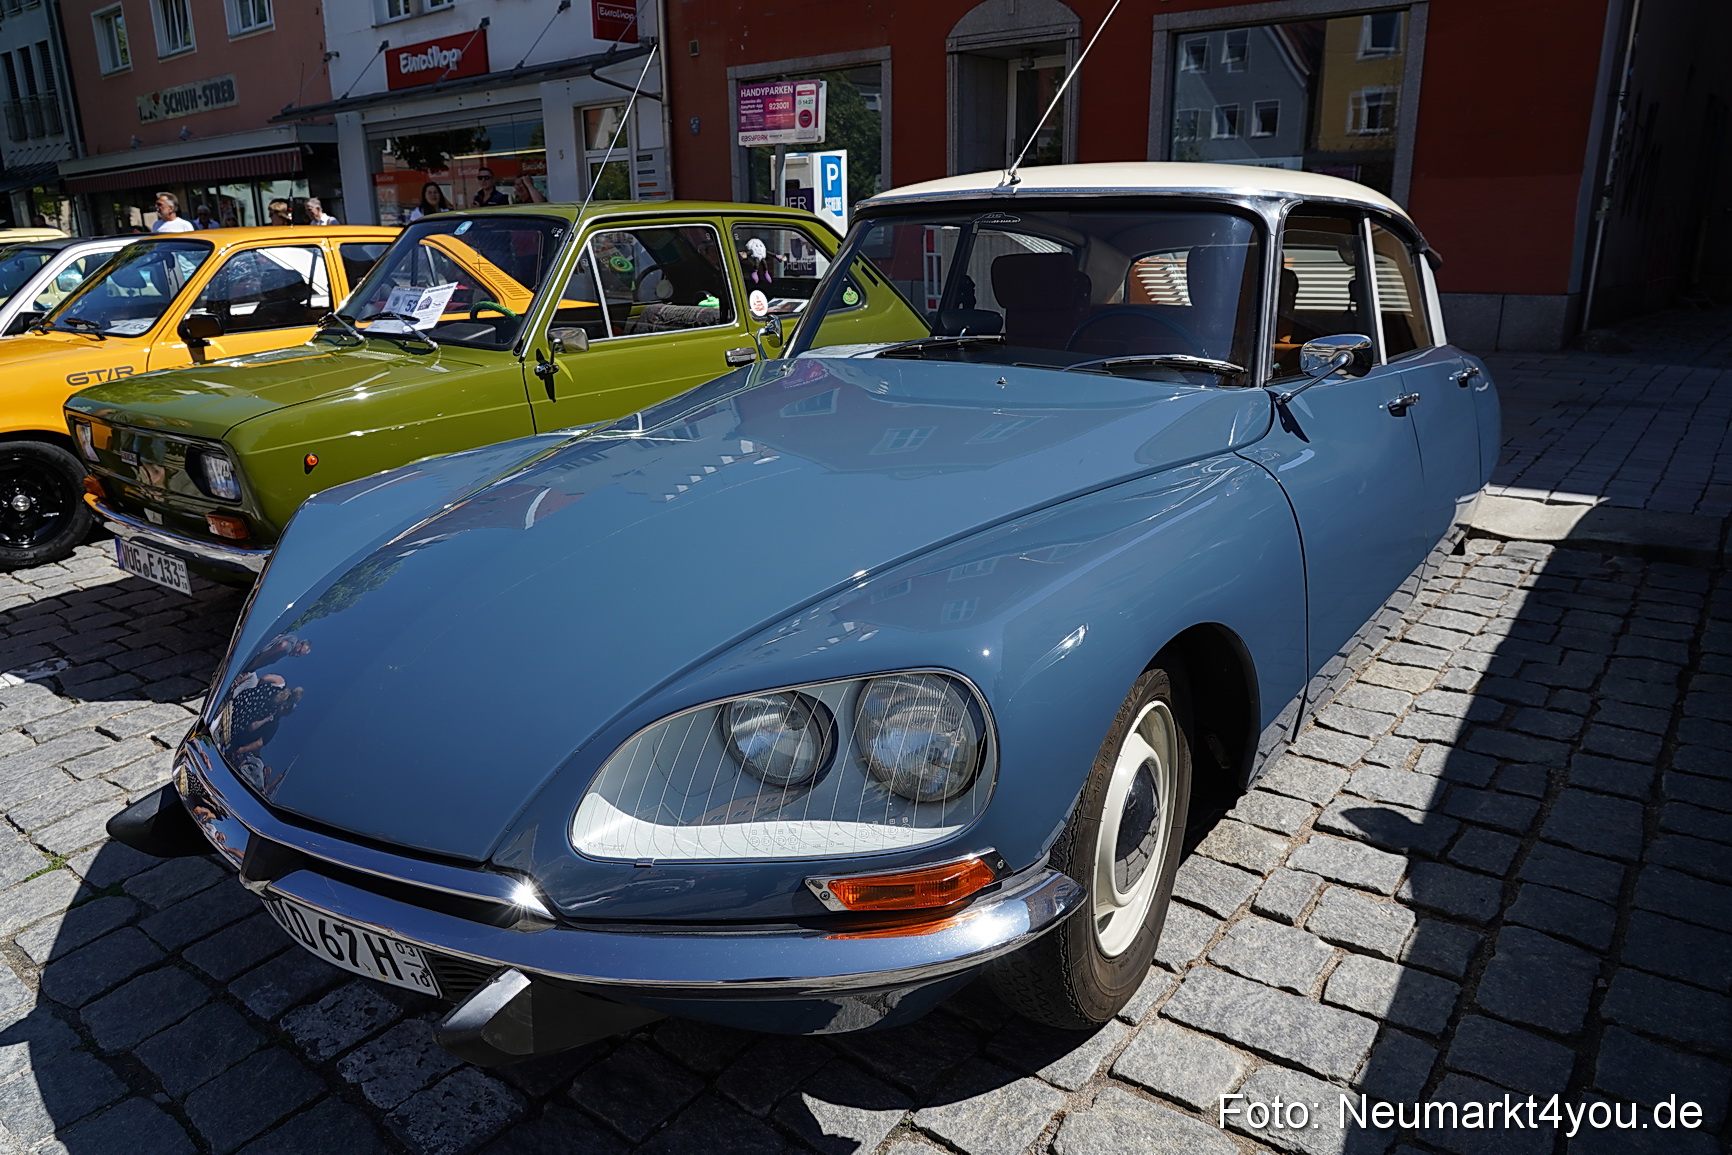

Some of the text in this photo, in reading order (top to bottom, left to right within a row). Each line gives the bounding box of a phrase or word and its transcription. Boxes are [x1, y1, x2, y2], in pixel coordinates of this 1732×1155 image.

[740, 85, 794, 98] HANDYPARKEN
[768, 101, 790, 111] 923001
[826, 163, 839, 191] P
[66, 365, 134, 386] GT/R
[157, 557, 181, 588] 133
